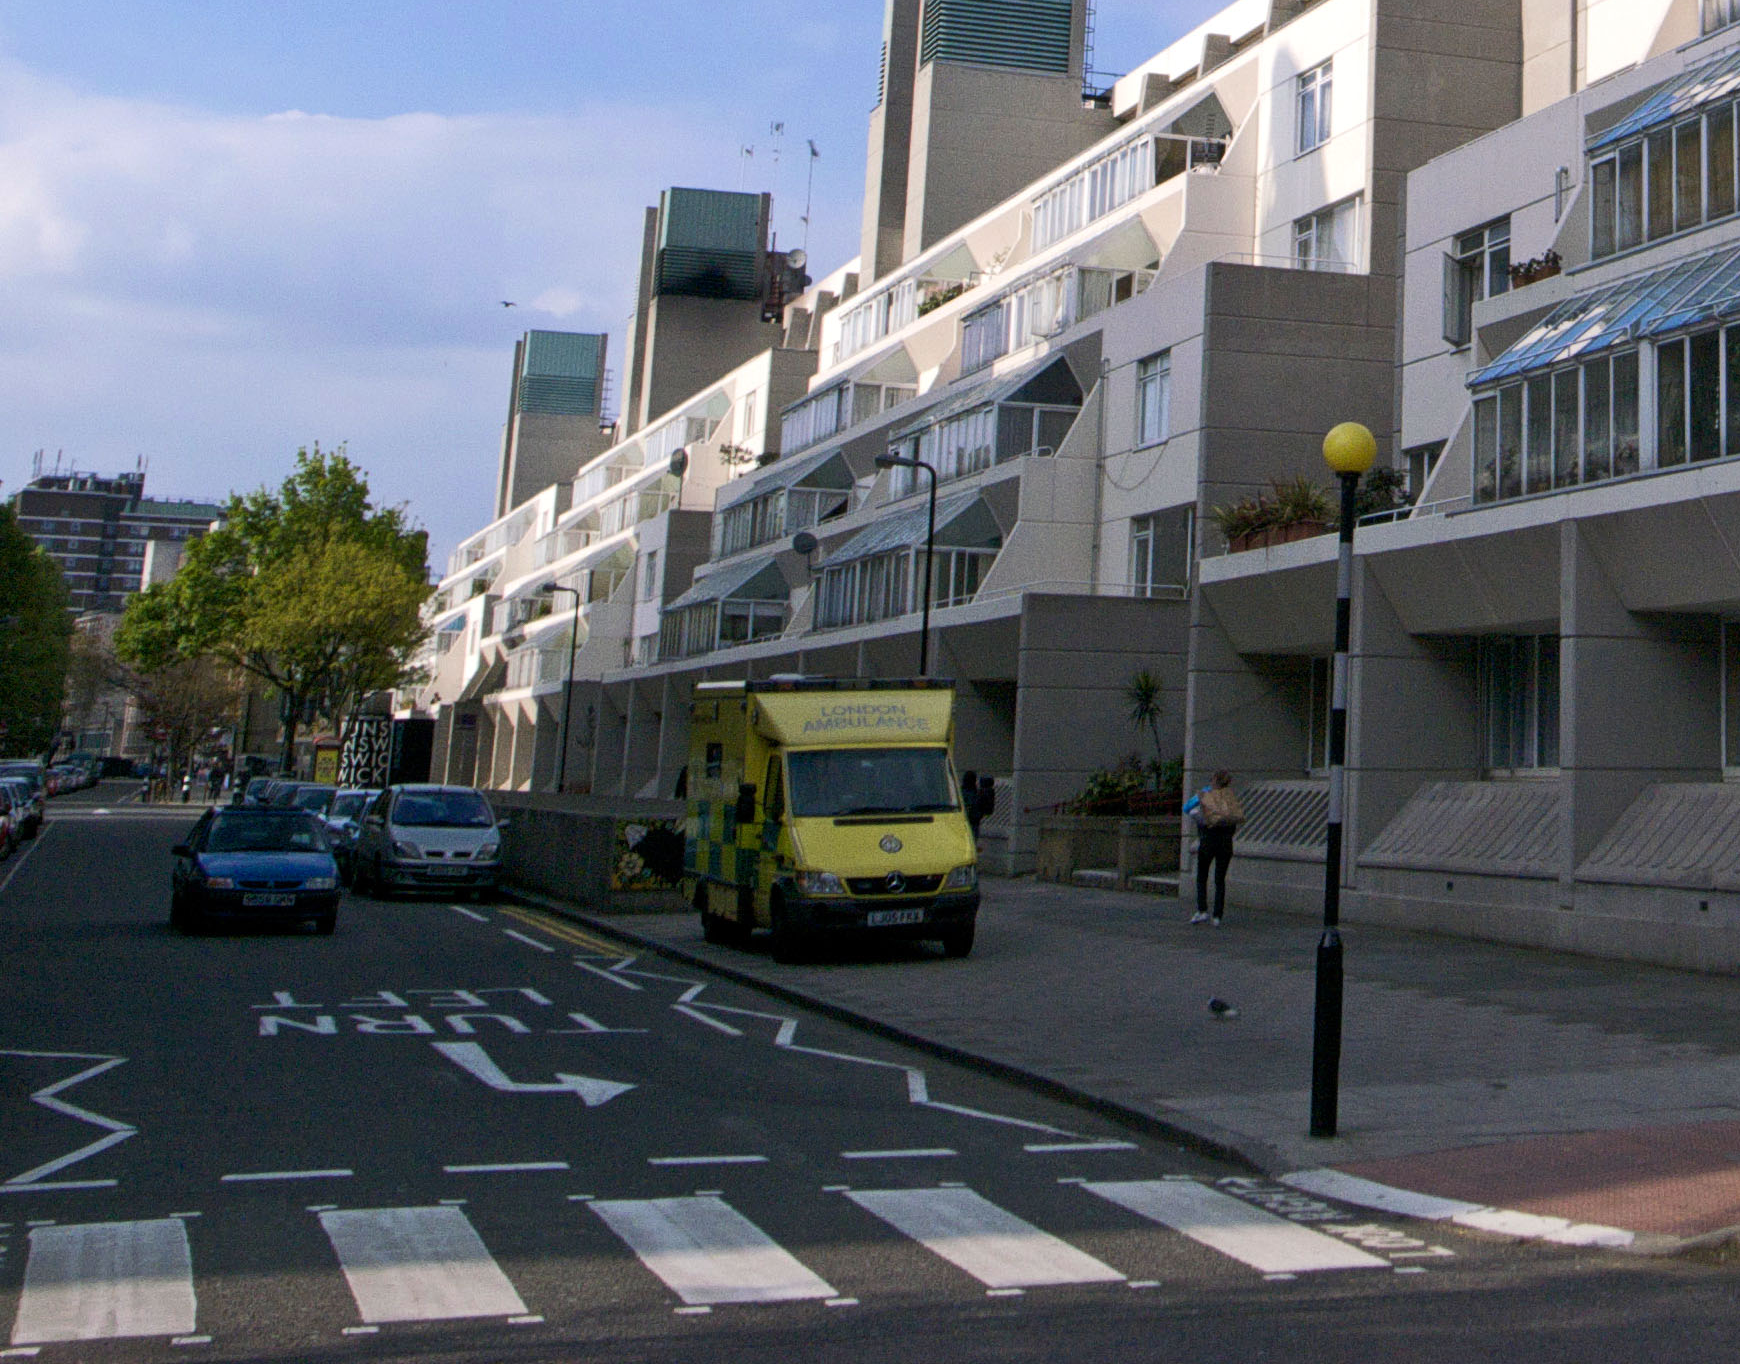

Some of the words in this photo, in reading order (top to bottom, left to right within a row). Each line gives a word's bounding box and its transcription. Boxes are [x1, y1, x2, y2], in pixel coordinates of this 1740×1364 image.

[820, 705, 906, 717] LONDON
[803, 716, 930, 733] AMBULANCE
[250, 987, 554, 1009] LEFT
[259, 1012, 650, 1036] TURN
